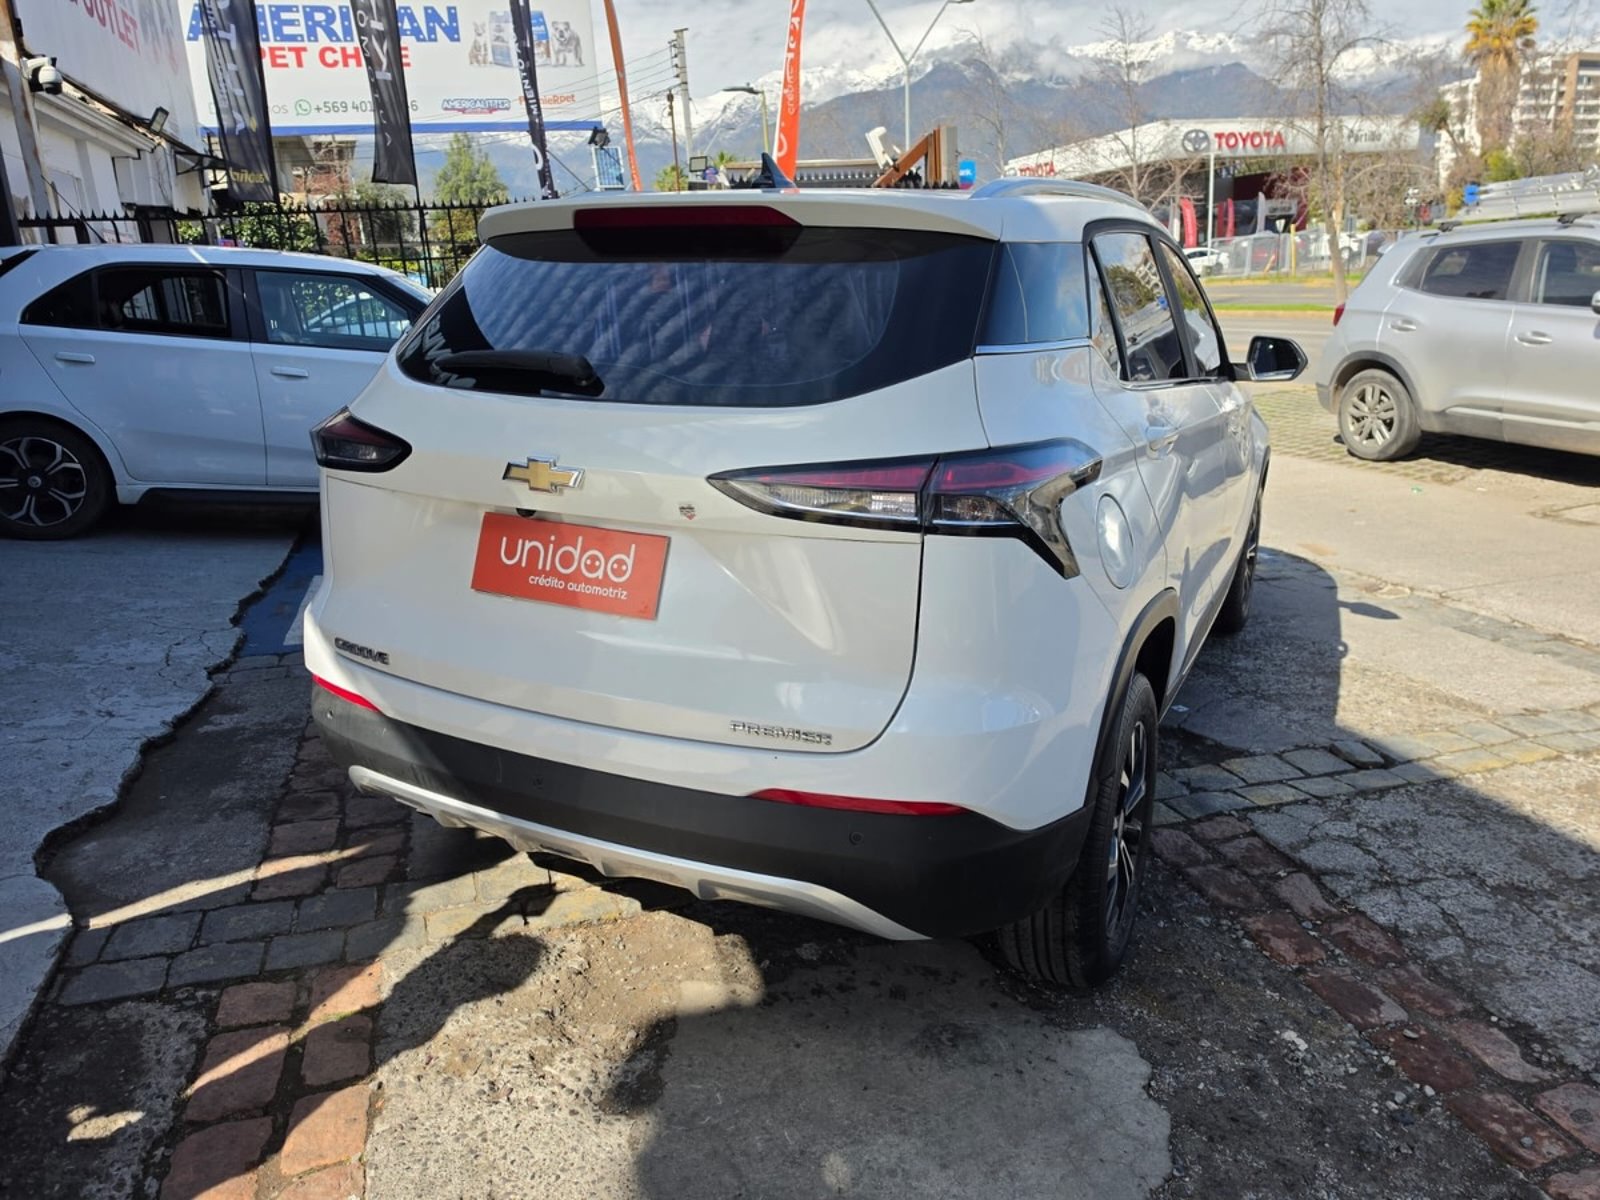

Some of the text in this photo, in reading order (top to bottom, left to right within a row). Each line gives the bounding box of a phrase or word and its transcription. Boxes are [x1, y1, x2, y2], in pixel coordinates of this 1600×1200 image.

[315, 102, 348, 113] +569
[1213, 131, 1285, 149] TOYOTA
[1018, 161, 1056, 176] TOYOTA
[501, 535, 636, 582] unidad
[528, 574, 628, 600] crédito automotriz
[334, 637, 390, 665] GROOVE
[730, 720, 833, 745] PREMIER
